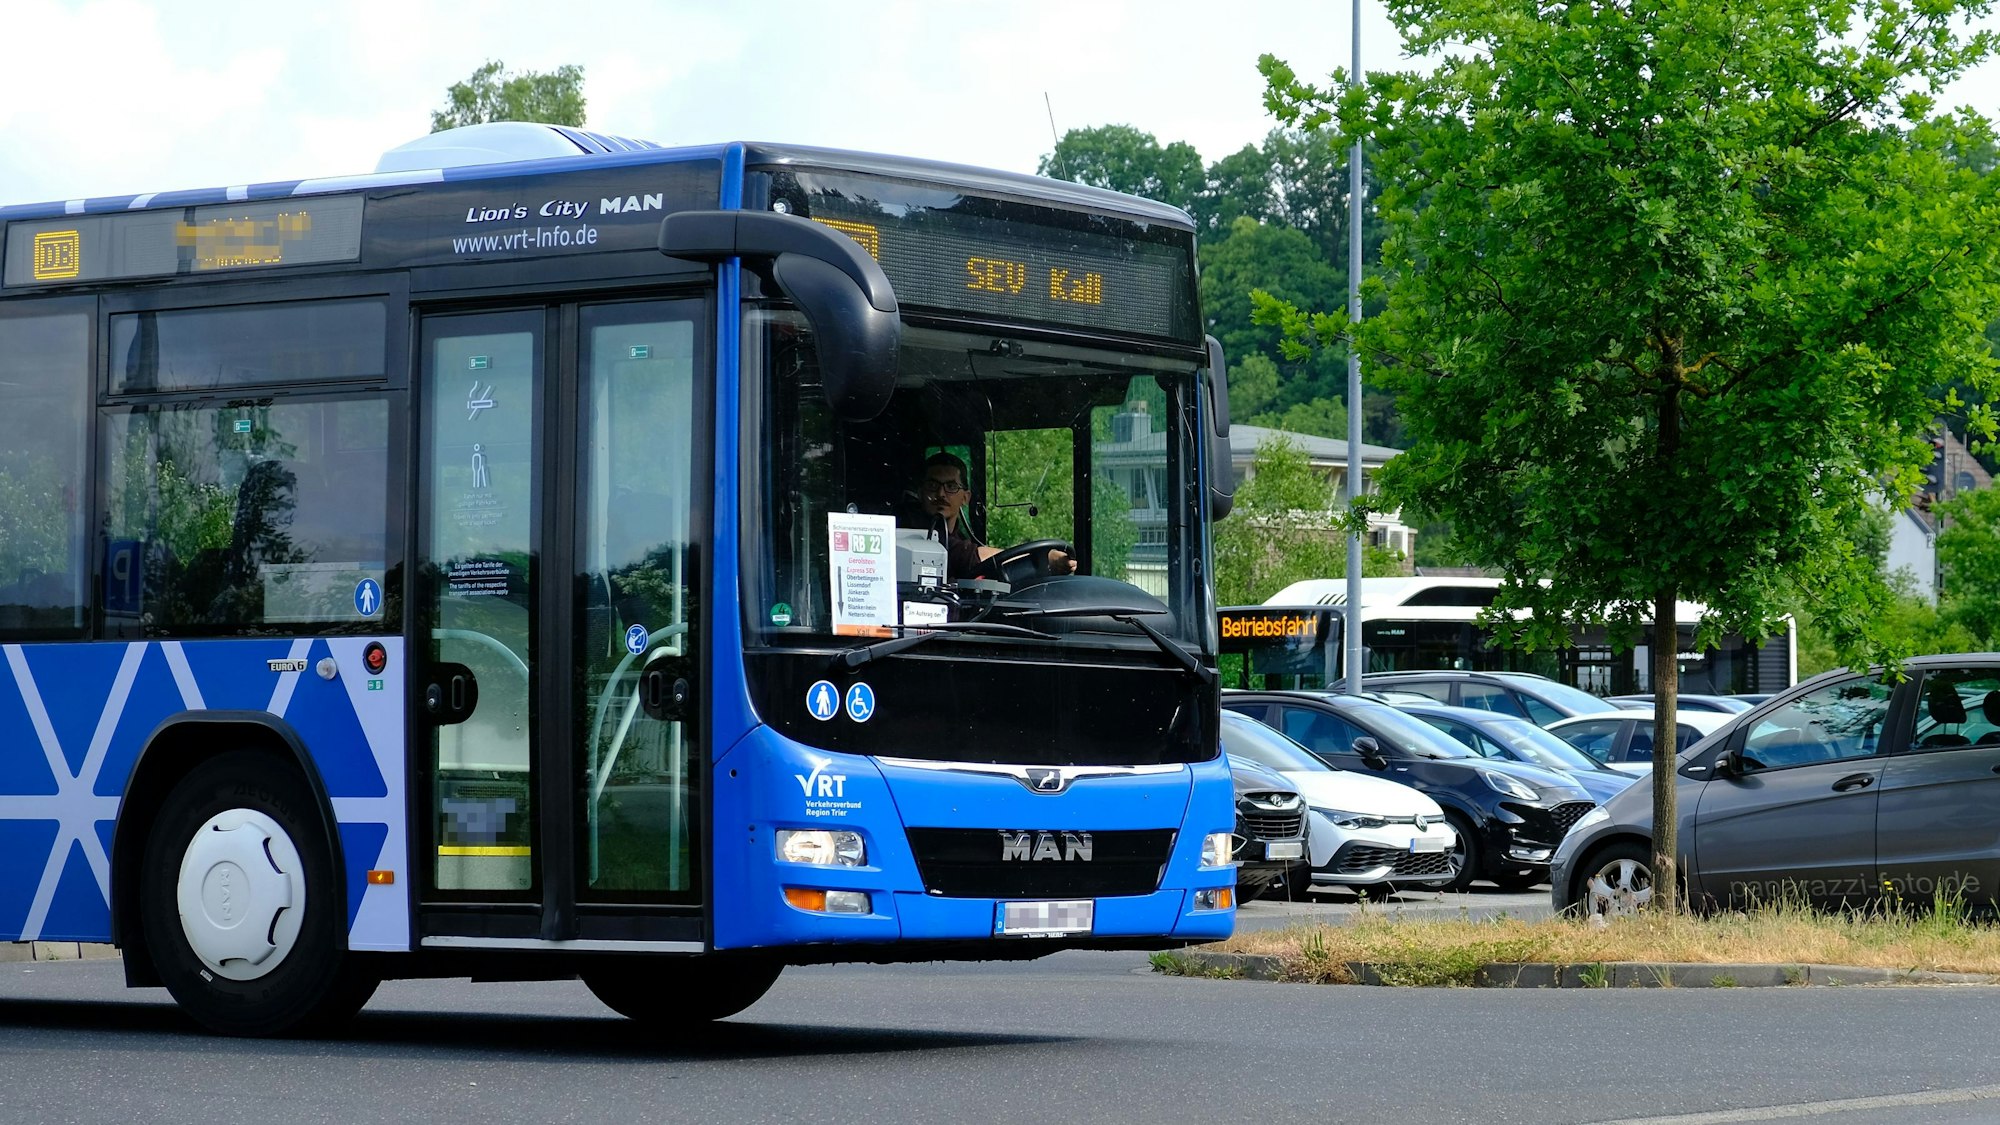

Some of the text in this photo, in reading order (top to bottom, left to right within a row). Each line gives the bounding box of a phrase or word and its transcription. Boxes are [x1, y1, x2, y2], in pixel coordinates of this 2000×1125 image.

[466, 193, 663, 223] Lion's City MAN
[453, 223, 598, 253] www.vrt-Info.de
[967, 257, 1102, 304] SEV Kall
[852, 534, 866, 553] RB
[870, 534, 881, 553] 22
[1222, 615, 1318, 638] Betriebsfahrt
[270, 660, 304, 672] EURO 6
[794, 757, 847, 798] VRT
[805, 800, 862, 809] Verkehrsverbund
[805, 808, 848, 818] Region Trier
[1001, 832, 1093, 861] MAN
